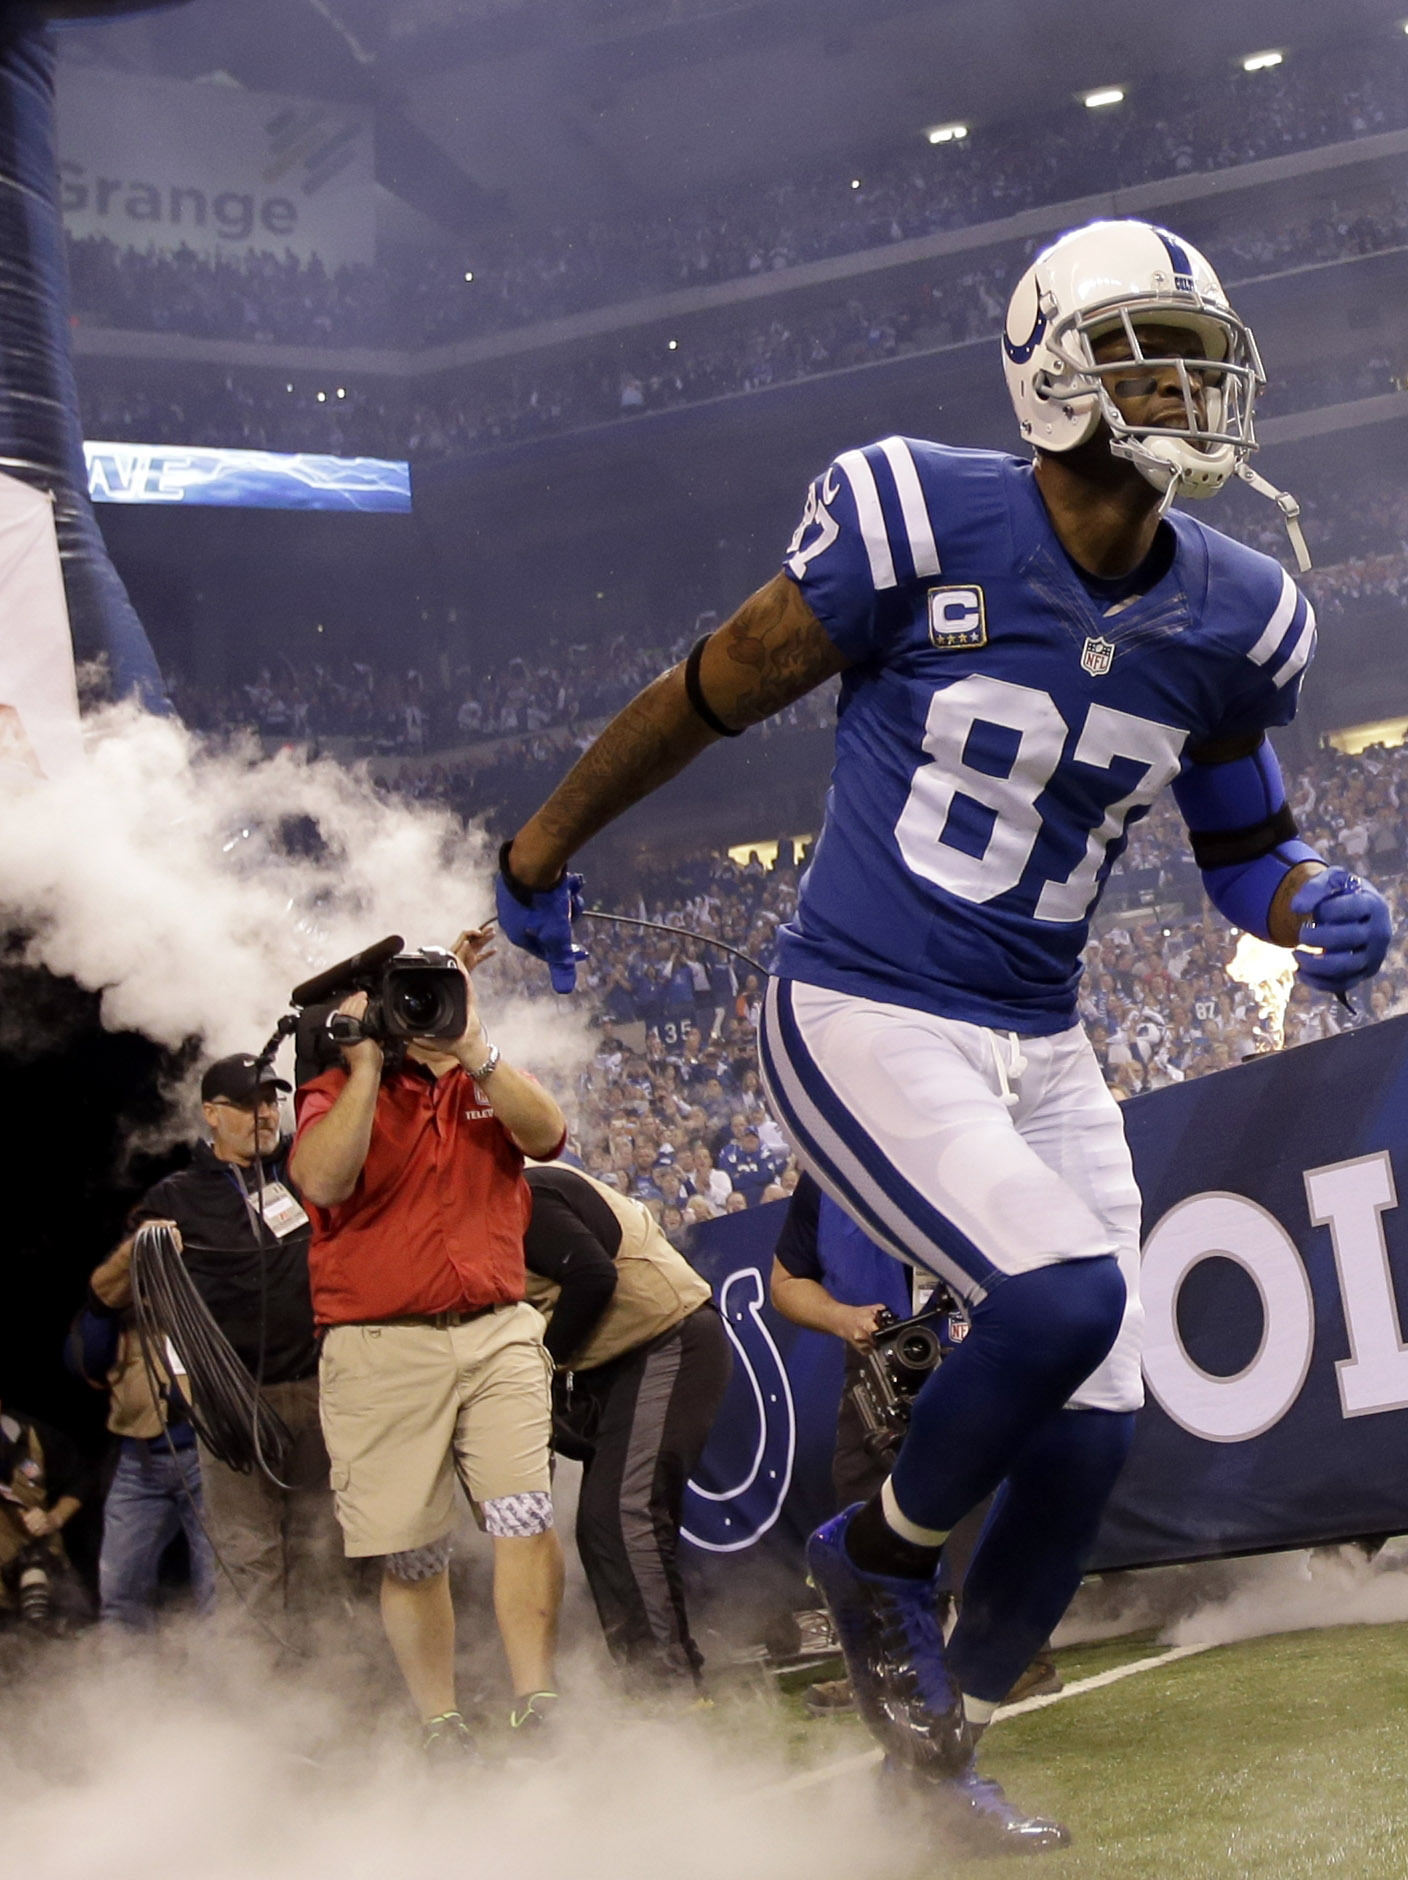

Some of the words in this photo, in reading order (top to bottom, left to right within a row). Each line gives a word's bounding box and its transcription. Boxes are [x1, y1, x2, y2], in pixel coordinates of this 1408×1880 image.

[57, 160, 298, 240] Grange
[932, 590, 979, 634] C
[1085, 652, 1108, 671] NFL
[893, 673, 1190, 922] 87
[1195, 1001, 1216, 1020] 87
